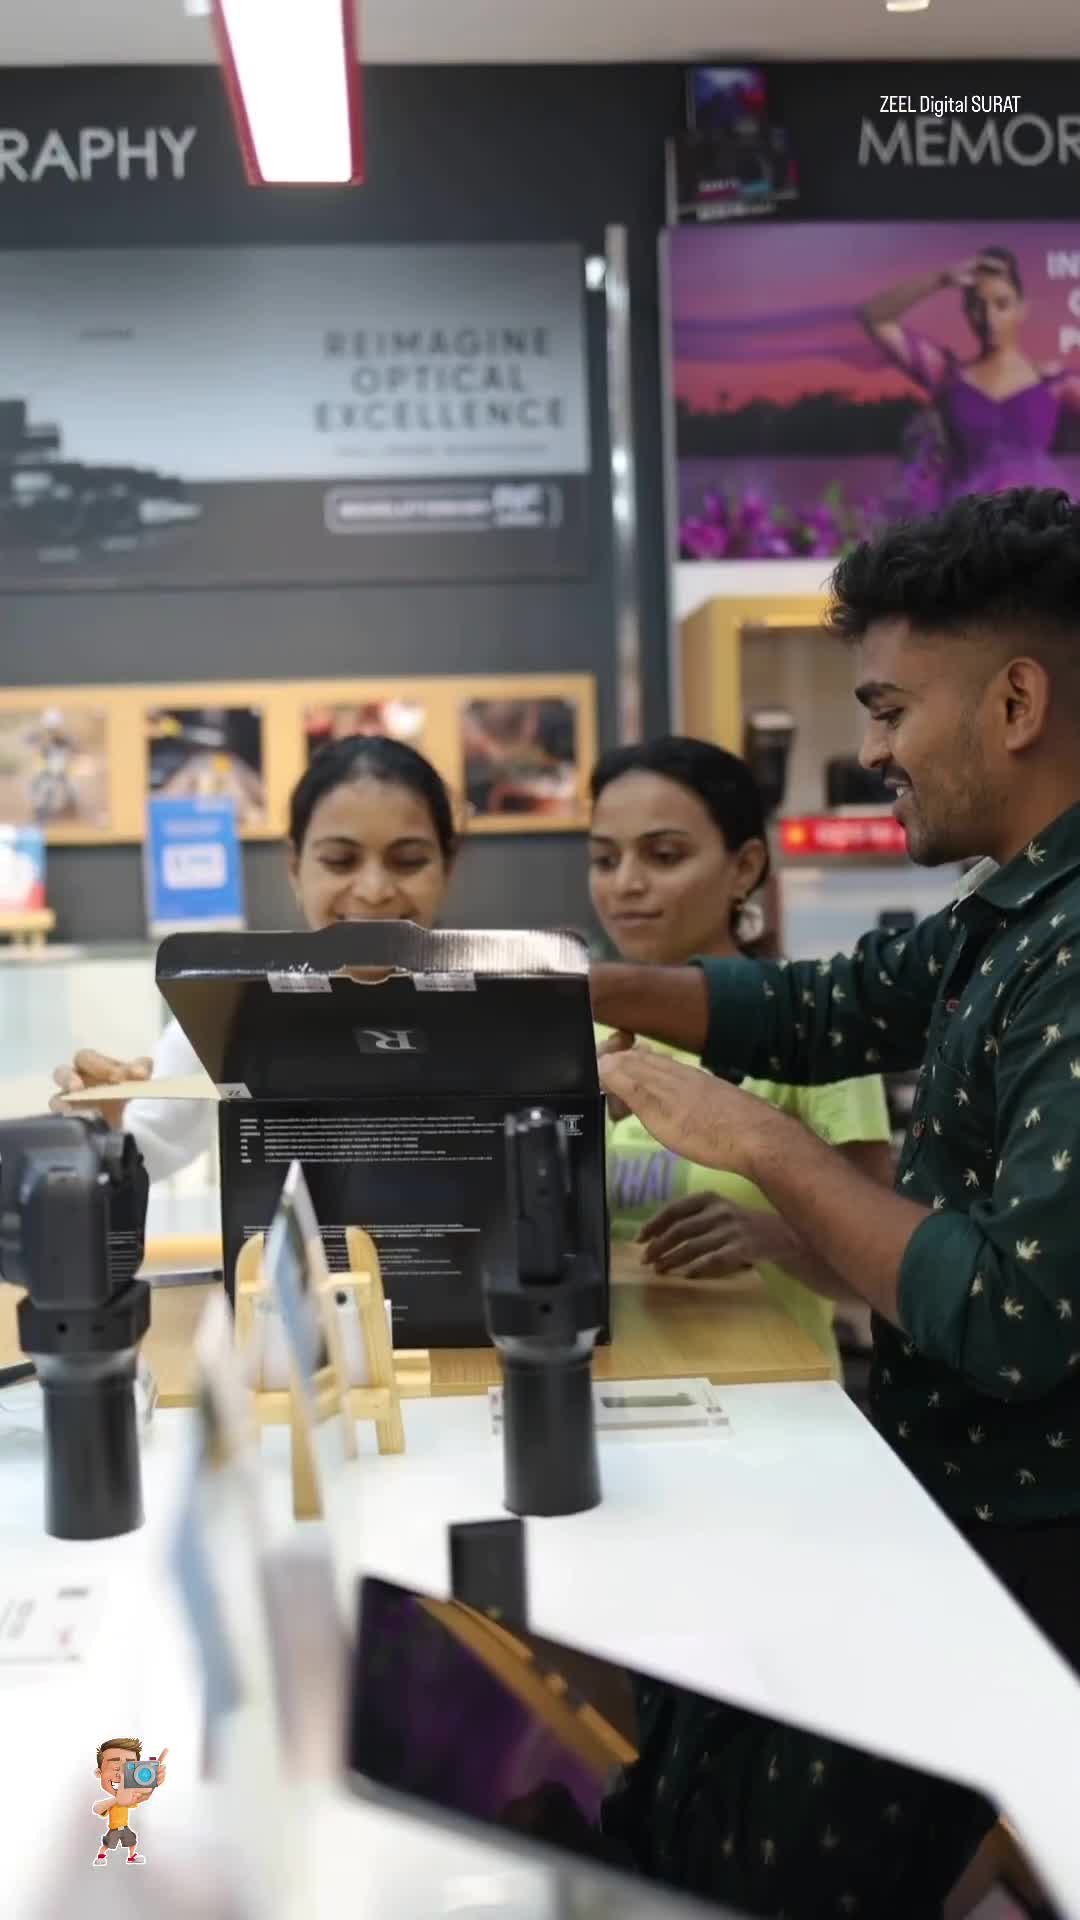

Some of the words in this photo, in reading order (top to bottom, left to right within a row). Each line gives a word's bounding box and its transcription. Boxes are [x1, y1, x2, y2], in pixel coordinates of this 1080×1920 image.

[324, 327, 552, 359] REIMAGINE
[351, 363, 526, 396] OPTICAL
[313, 396, 567, 433] EXCELLENCE
